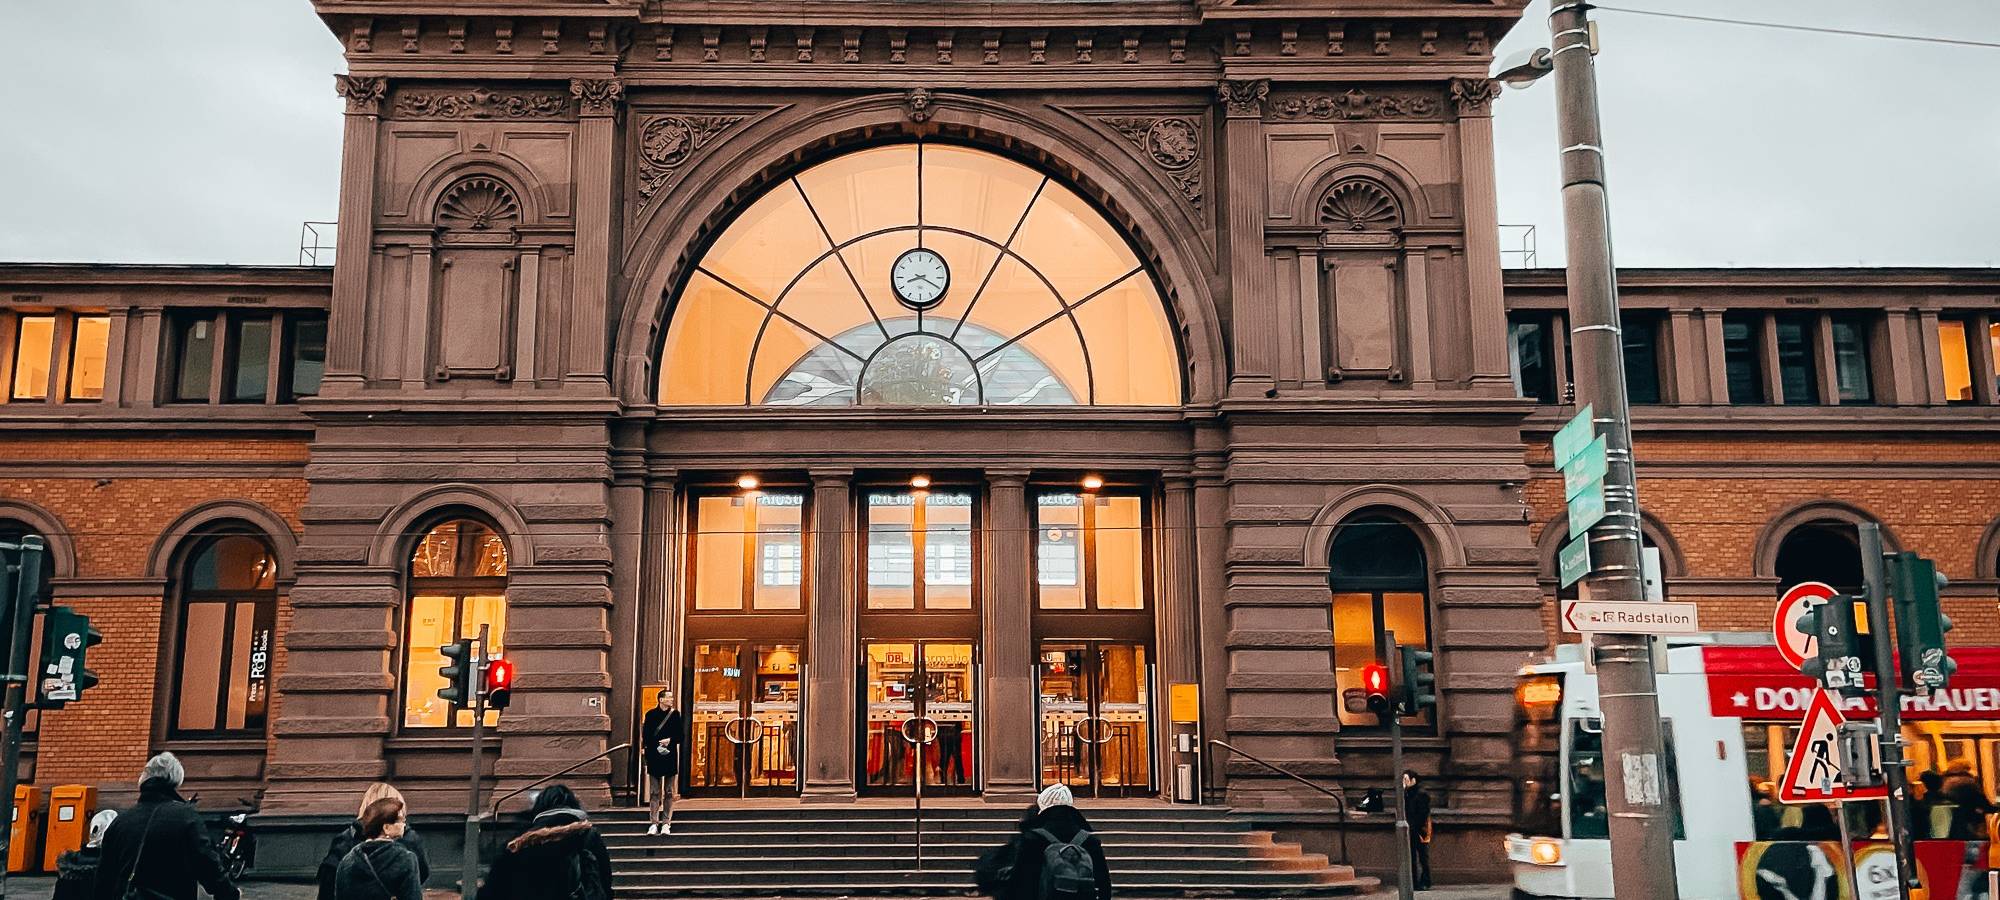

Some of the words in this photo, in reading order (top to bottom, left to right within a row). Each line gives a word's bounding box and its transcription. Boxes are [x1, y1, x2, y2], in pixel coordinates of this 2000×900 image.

[655, 129, 680, 151] SALVE
[1618, 611, 1689, 624] Radstation
[887, 654, 901, 663] DB
